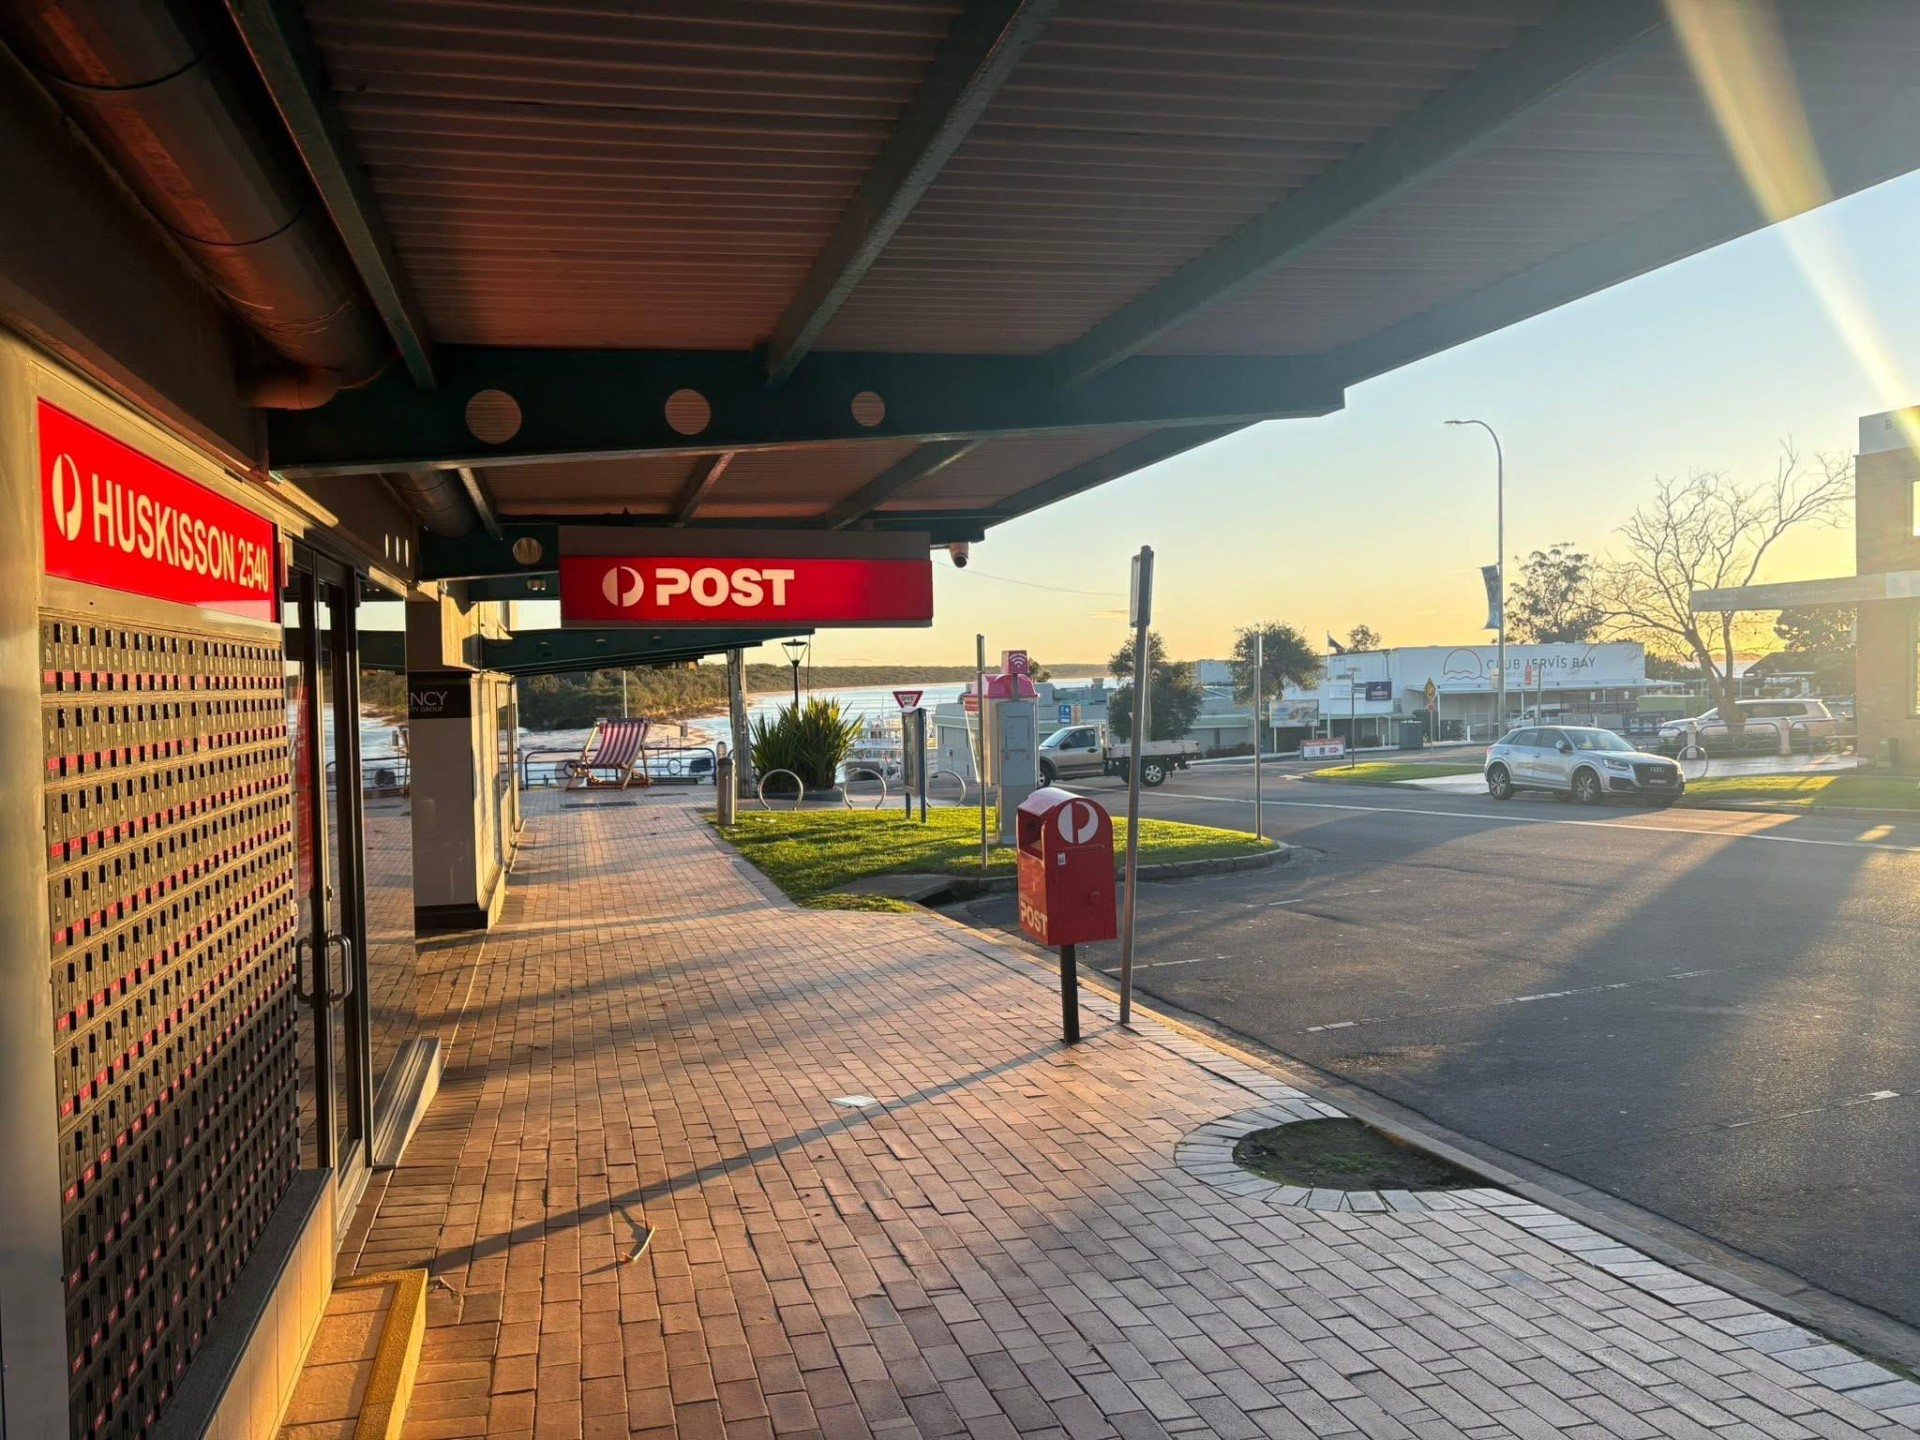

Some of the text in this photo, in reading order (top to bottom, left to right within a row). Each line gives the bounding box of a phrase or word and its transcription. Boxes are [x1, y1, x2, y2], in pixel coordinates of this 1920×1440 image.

[91, 473, 270, 593] HUSKISSON 2540
[655, 567, 795, 607] POST
[1572, 657, 1596, 668] BAY
[407, 691, 448, 706] NCY
[1020, 900, 1048, 936] POST
